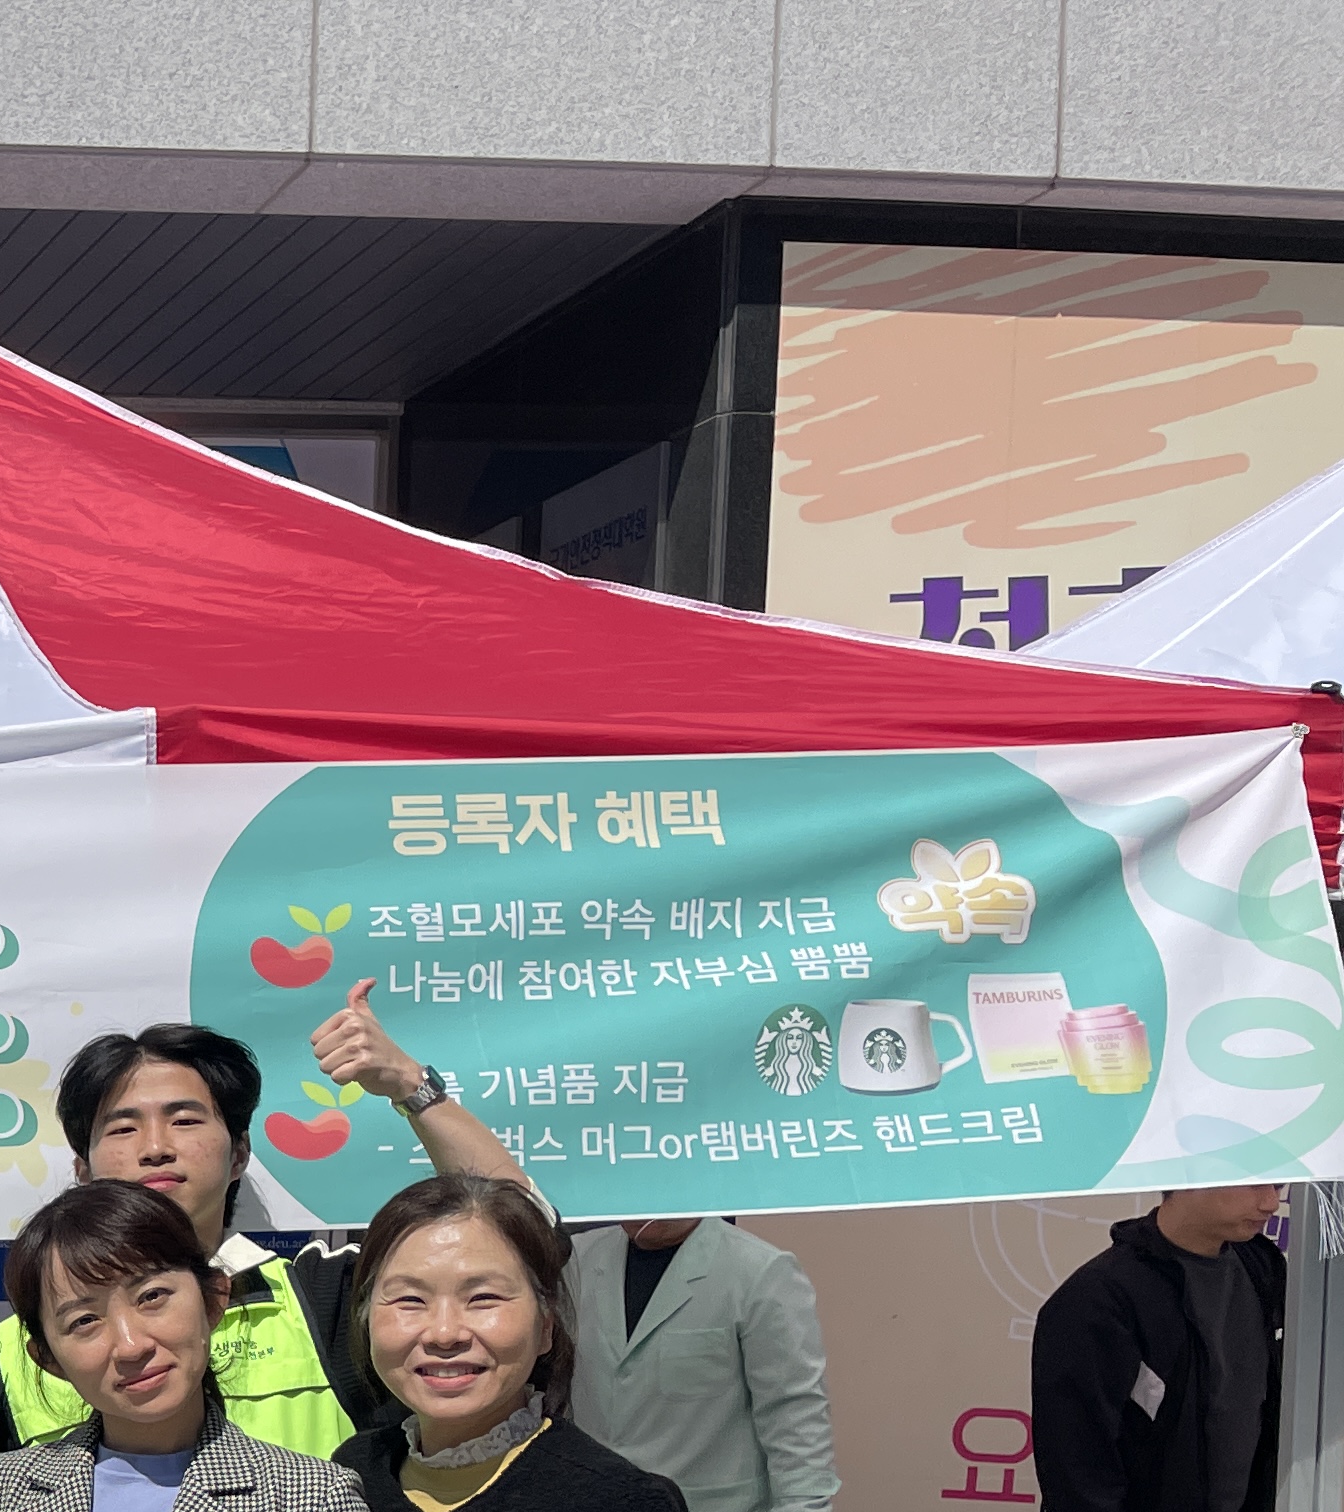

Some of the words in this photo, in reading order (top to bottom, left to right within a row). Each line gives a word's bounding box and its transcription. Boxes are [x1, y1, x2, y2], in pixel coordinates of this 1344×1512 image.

[387, 791, 579, 857] 등록자
[594, 788, 727, 850] 혜택
[367, 898, 567, 942] 조혈모세포
[580, 897, 658, 941] 약속
[669, 896, 743, 939] 배지
[757, 895, 837, 936] 지급
[388, 958, 504, 1003] 나눔에
[517, 958, 638, 1001] 참여한
[653, 951, 779, 991] 자부심
[789, 941, 874, 981] 뿜뿜
[972, 988, 1064, 1005] TAMBURINS
[479, 1062, 600, 1107] 기념품
[612, 1060, 690, 1104] 지급
[581, 1119, 864, 1164] 머그or탬버린즈
[872, 1103, 1045, 1153] 핸드크림
